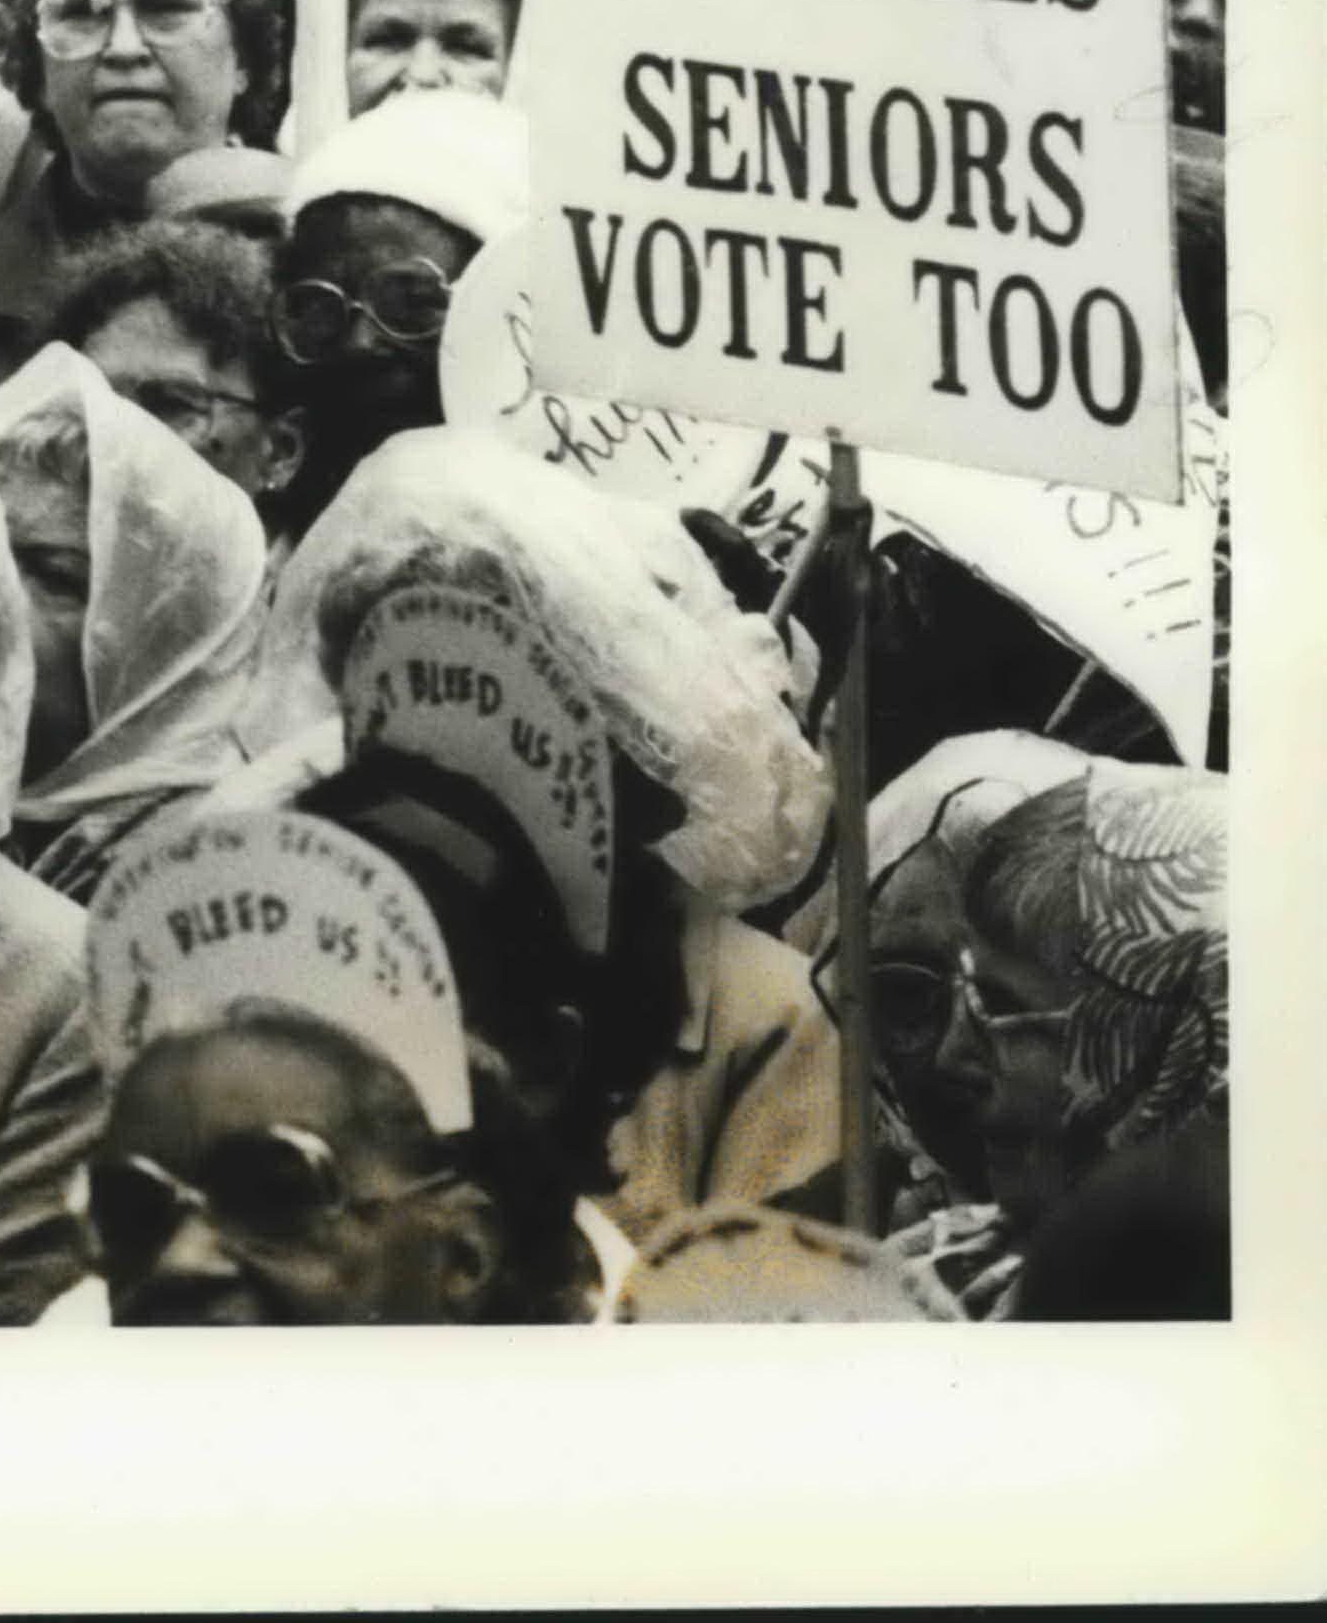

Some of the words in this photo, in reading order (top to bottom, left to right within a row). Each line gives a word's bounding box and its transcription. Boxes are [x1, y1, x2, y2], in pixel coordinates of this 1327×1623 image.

[622, 52, 1087, 248] SENIORS
[561, 206, 847, 373] VOTE
[913, 258, 1144, 428] TOO
[406, 658, 503, 718] BLEED
[165, 890, 290, 958] BLEED
